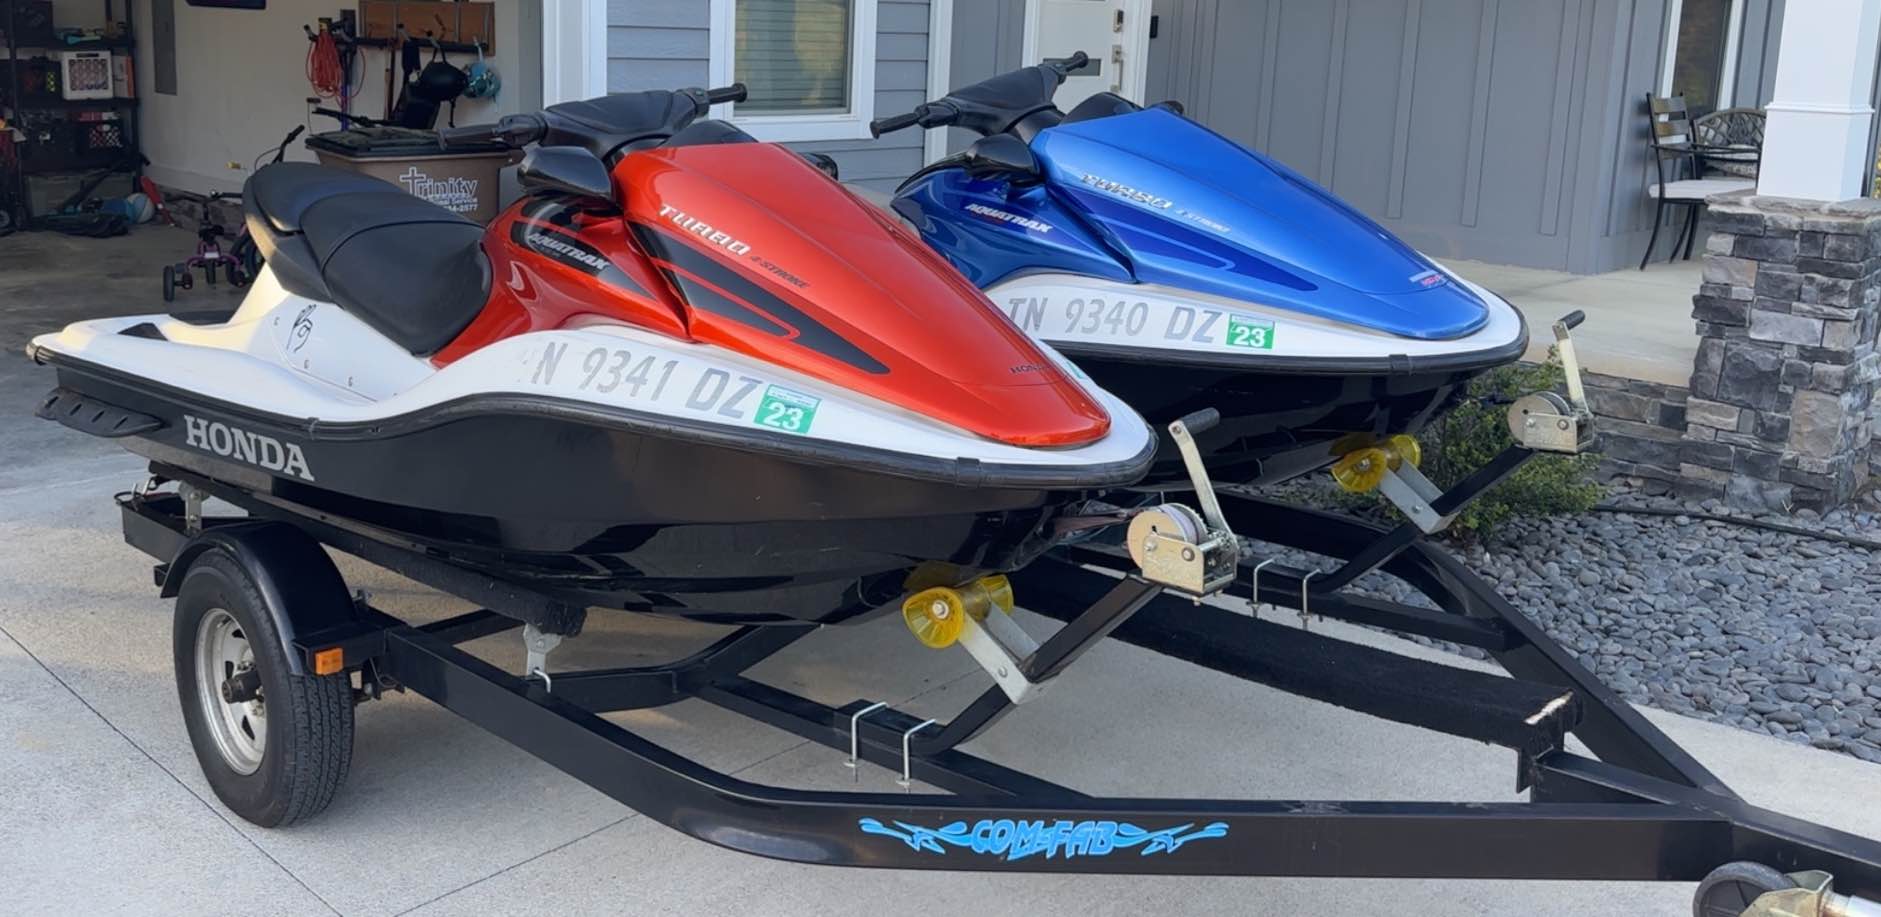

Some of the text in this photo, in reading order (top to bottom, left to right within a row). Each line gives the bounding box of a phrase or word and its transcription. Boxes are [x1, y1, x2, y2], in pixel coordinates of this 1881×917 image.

[400, 167, 478, 198] Trinity
[659, 203, 752, 256] TURBO
[964, 203, 1054, 233] AQUATRAX
[528, 231, 612, 271] AQUATRAX
[1008, 297, 1223, 343] TN 9340 DZ
[1232, 326, 1266, 347] 23
[579, 347, 679, 401] 9341
[685, 367, 763, 419] DZ
[763, 402, 804, 430] 23
[184, 414, 315, 482] HONDA
